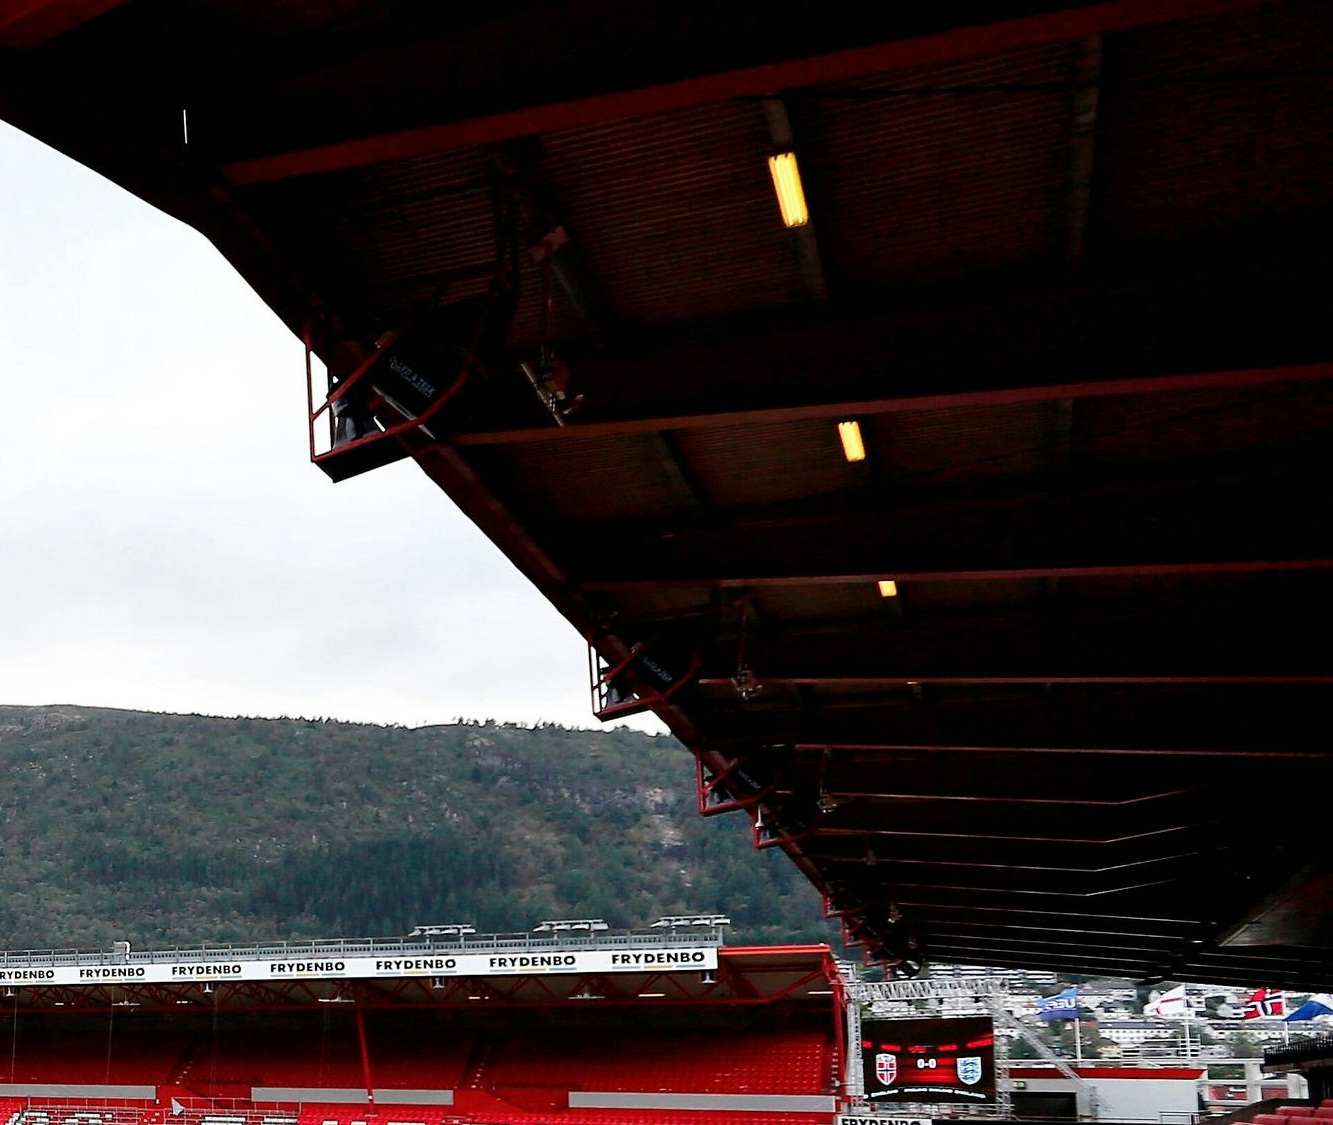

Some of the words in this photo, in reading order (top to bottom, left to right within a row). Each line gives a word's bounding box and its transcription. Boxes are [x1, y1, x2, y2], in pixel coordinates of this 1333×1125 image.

[375, 958, 456, 971] FRYDENBØ
[489, 955, 576, 968] FRYDENBØ
[611, 951, 705, 966] FRYDENBØ
[171, 964, 242, 976] FRYDENBØ
[270, 960, 346, 973] FRYDENBØ
[79, 967, 146, 980] FRYDENBØ
[916, 1058, 937, 1069] 0-0
